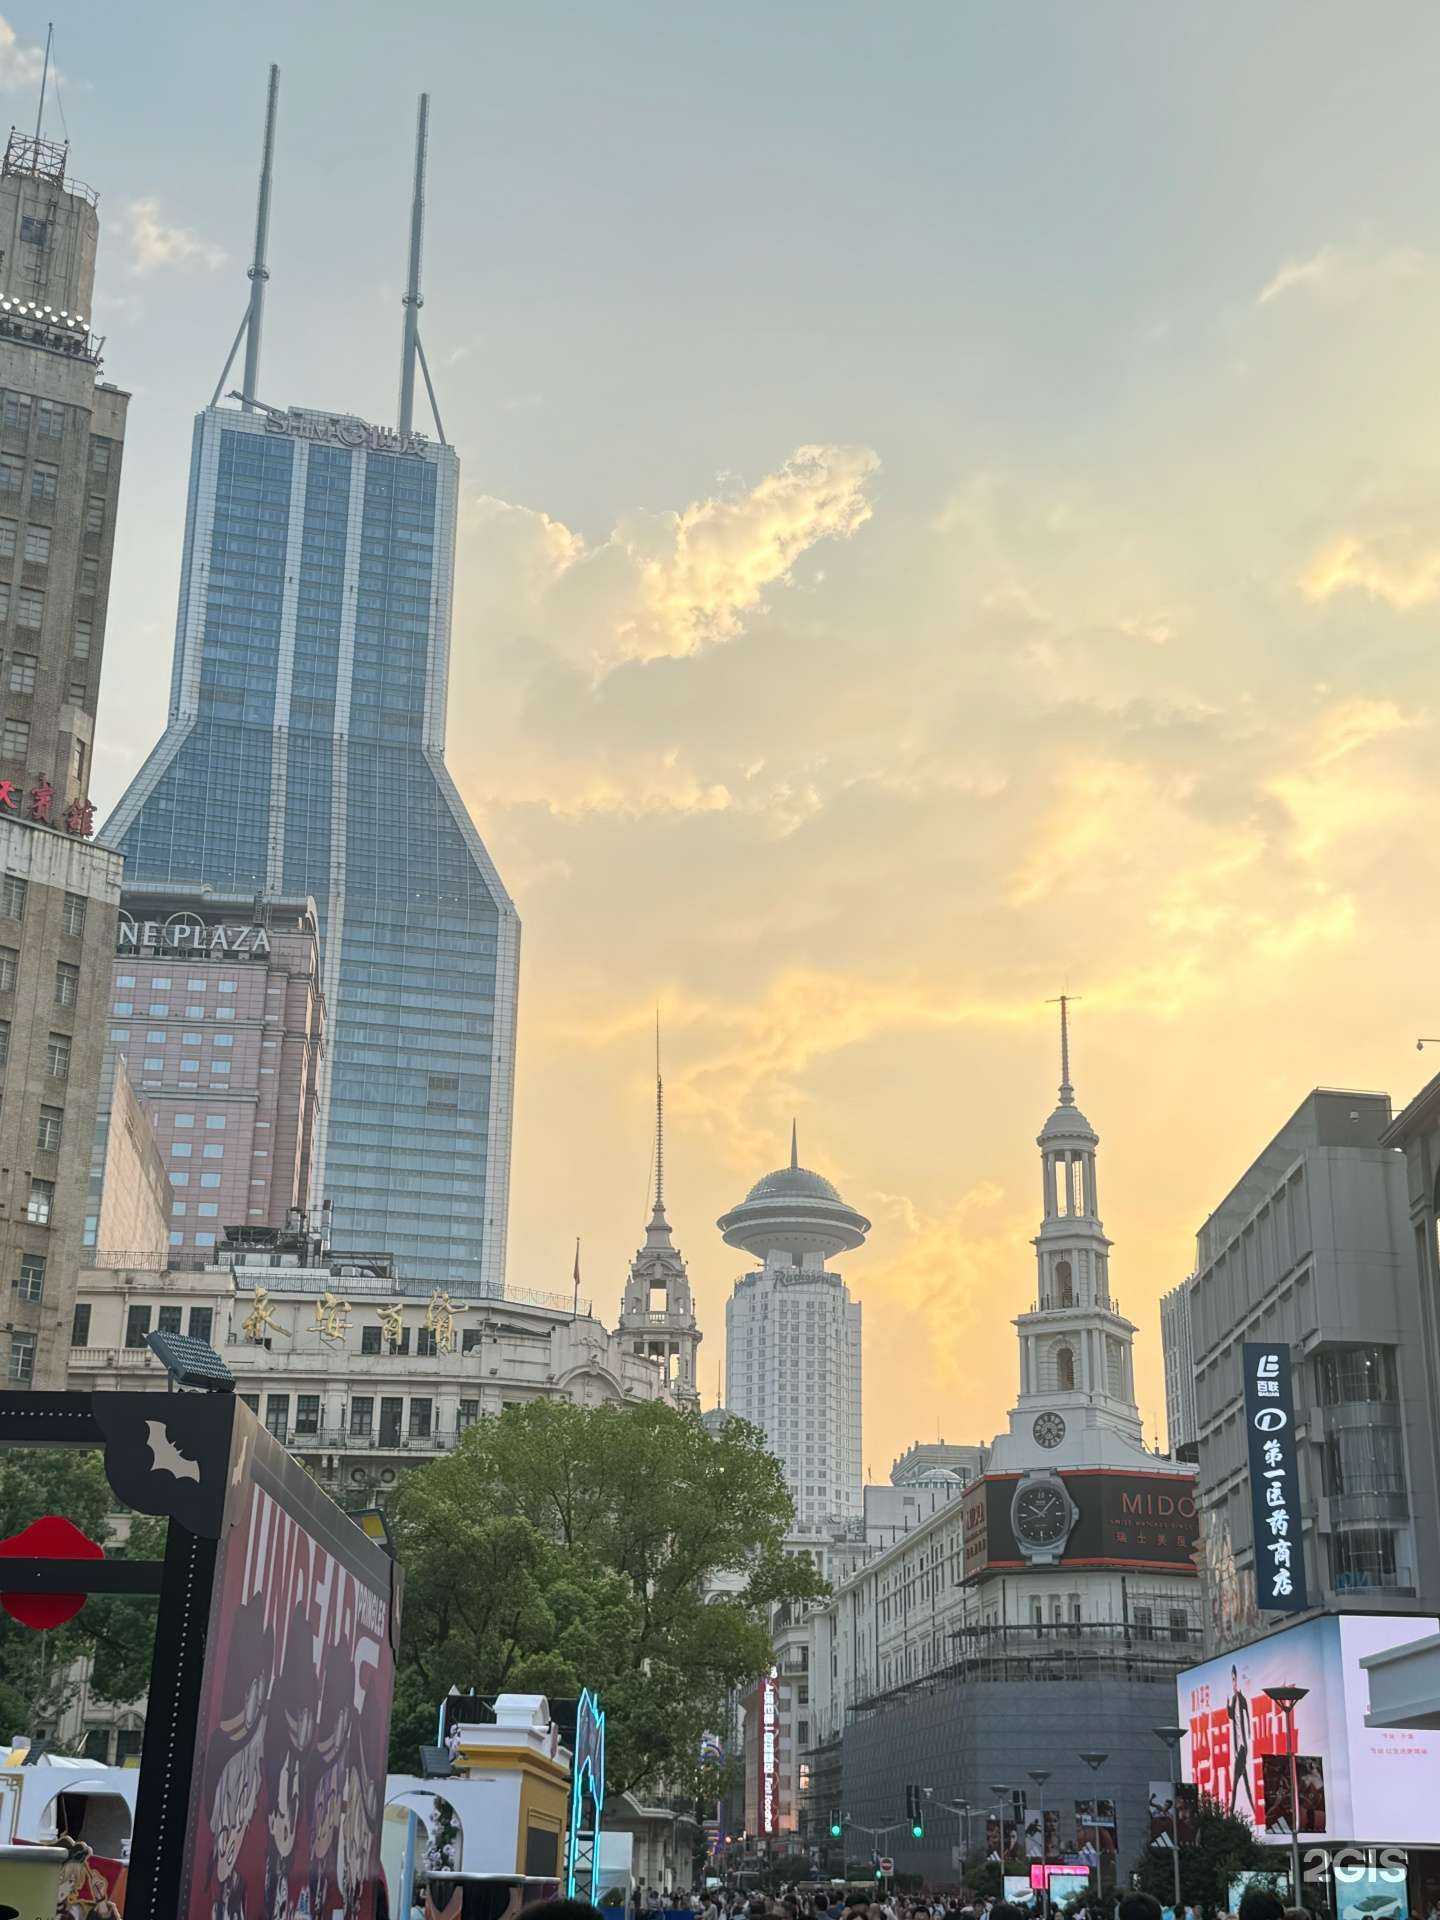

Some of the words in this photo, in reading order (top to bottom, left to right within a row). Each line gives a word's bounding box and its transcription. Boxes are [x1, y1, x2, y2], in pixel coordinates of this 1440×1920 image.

[172, 924, 271, 952] PLAZA
[1121, 1492, 1197, 1519] MIDO
[1262, 1438, 1294, 1597] 第一医药商店
